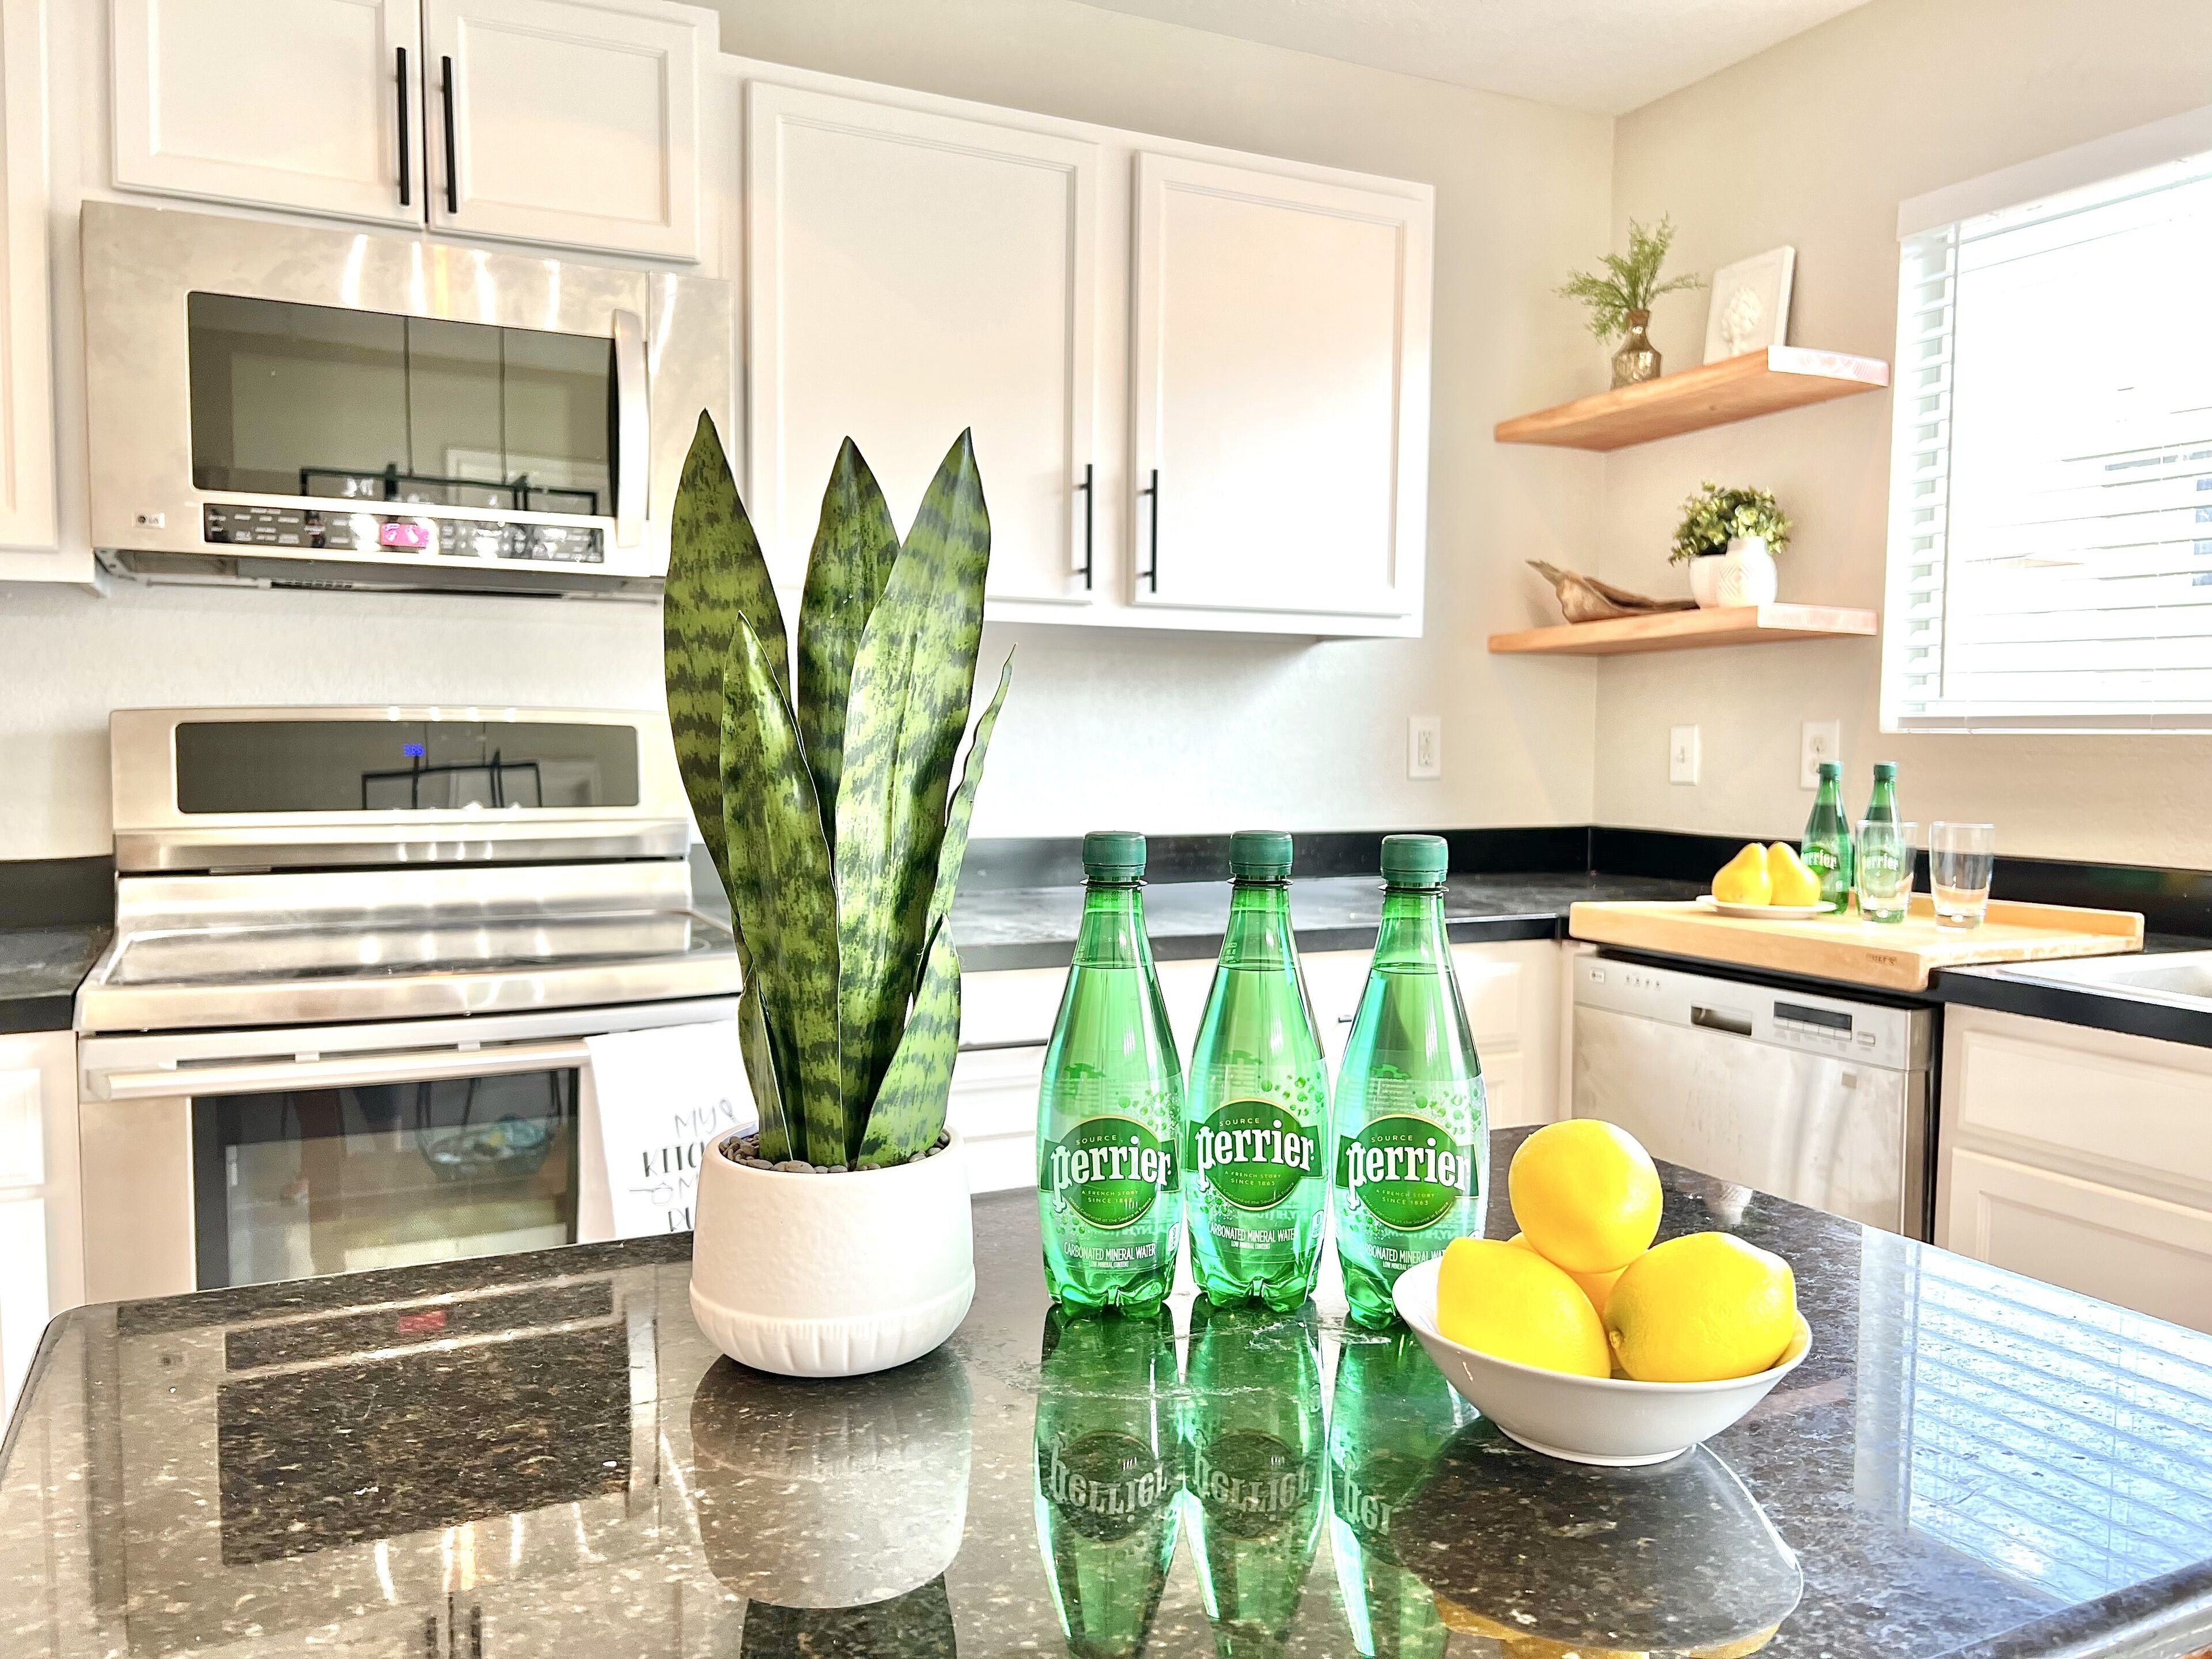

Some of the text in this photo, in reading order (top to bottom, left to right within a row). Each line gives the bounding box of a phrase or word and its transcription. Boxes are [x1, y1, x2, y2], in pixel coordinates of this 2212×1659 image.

[674, 1105, 717, 1138] MY
[1219, 1118, 1260, 1127] SOURCE
[1075, 1135, 1117, 1145] SOURCE
[1371, 1135, 1414, 1143] SOURCE
[1382, 1190, 1410, 1198] FRENCH
[1382, 1197, 1406, 1205] SINCE
[1118, 1214, 1135, 1222] Source
[1139, 1197, 1152, 1211] France
[1413, 1216, 1430, 1224] Source
[1434, 1202, 1449, 1215] France
[1207, 1221, 1294, 1243] CARBONATED MINERAL WATE
[1064, 1241, 1156, 1262] CARBONATED MINERAL WATER
[1365, 1242, 1398, 1262] RBONATED
